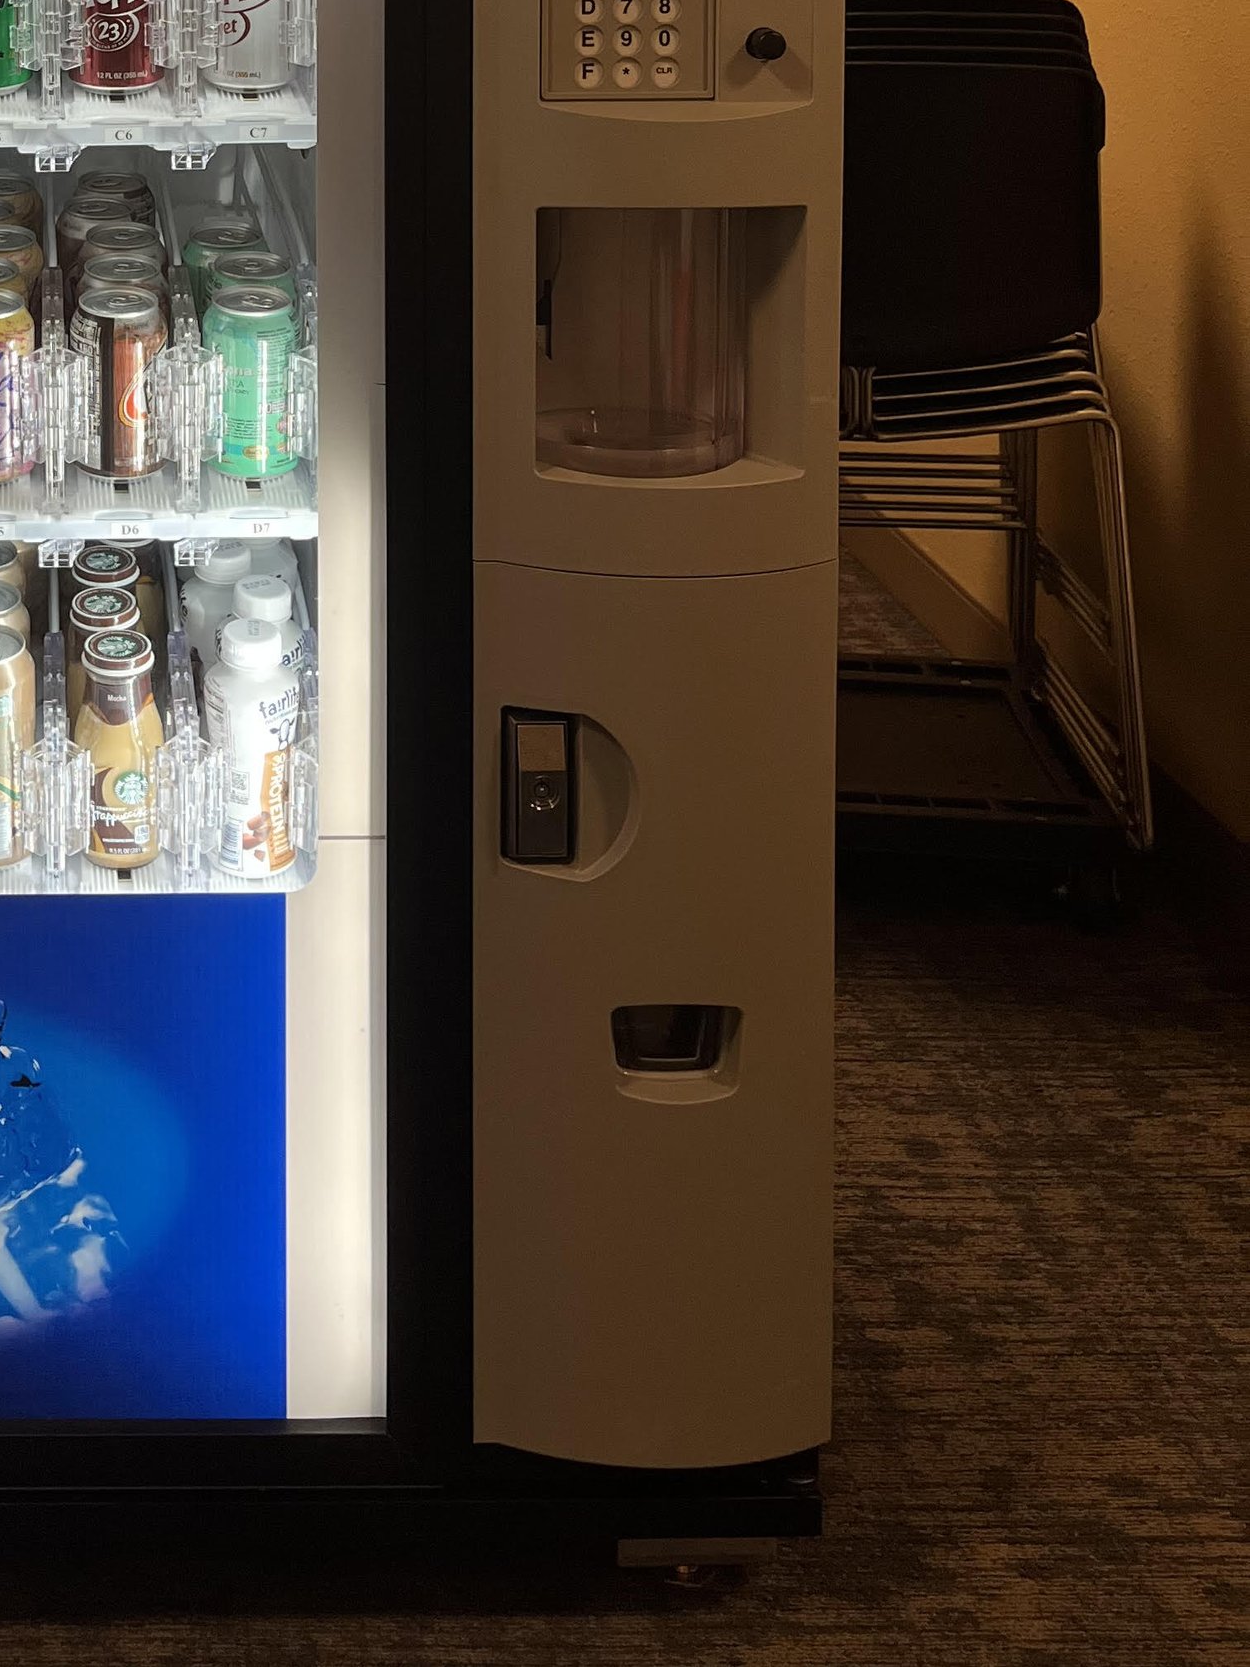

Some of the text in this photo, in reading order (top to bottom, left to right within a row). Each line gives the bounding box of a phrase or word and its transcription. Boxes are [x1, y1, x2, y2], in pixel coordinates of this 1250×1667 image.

[98, 21, 120, 42] 23
[581, 30, 595, 47] E
[620, 30, 632, 47] 9
[658, 30, 671, 47] 0
[96, 72, 104, 80] 12
[104, 72, 112, 80] FL
[113, 72, 122, 80] OZ
[582, 63, 595, 80] F
[655, 66, 673, 74] CLR
[114, 129, 133, 141] C6
[249, 126, 268, 139] C7
[121, 523, 140, 536] D6
[252, 522, 270, 534] D7
[107, 694, 127, 702] Mocha
